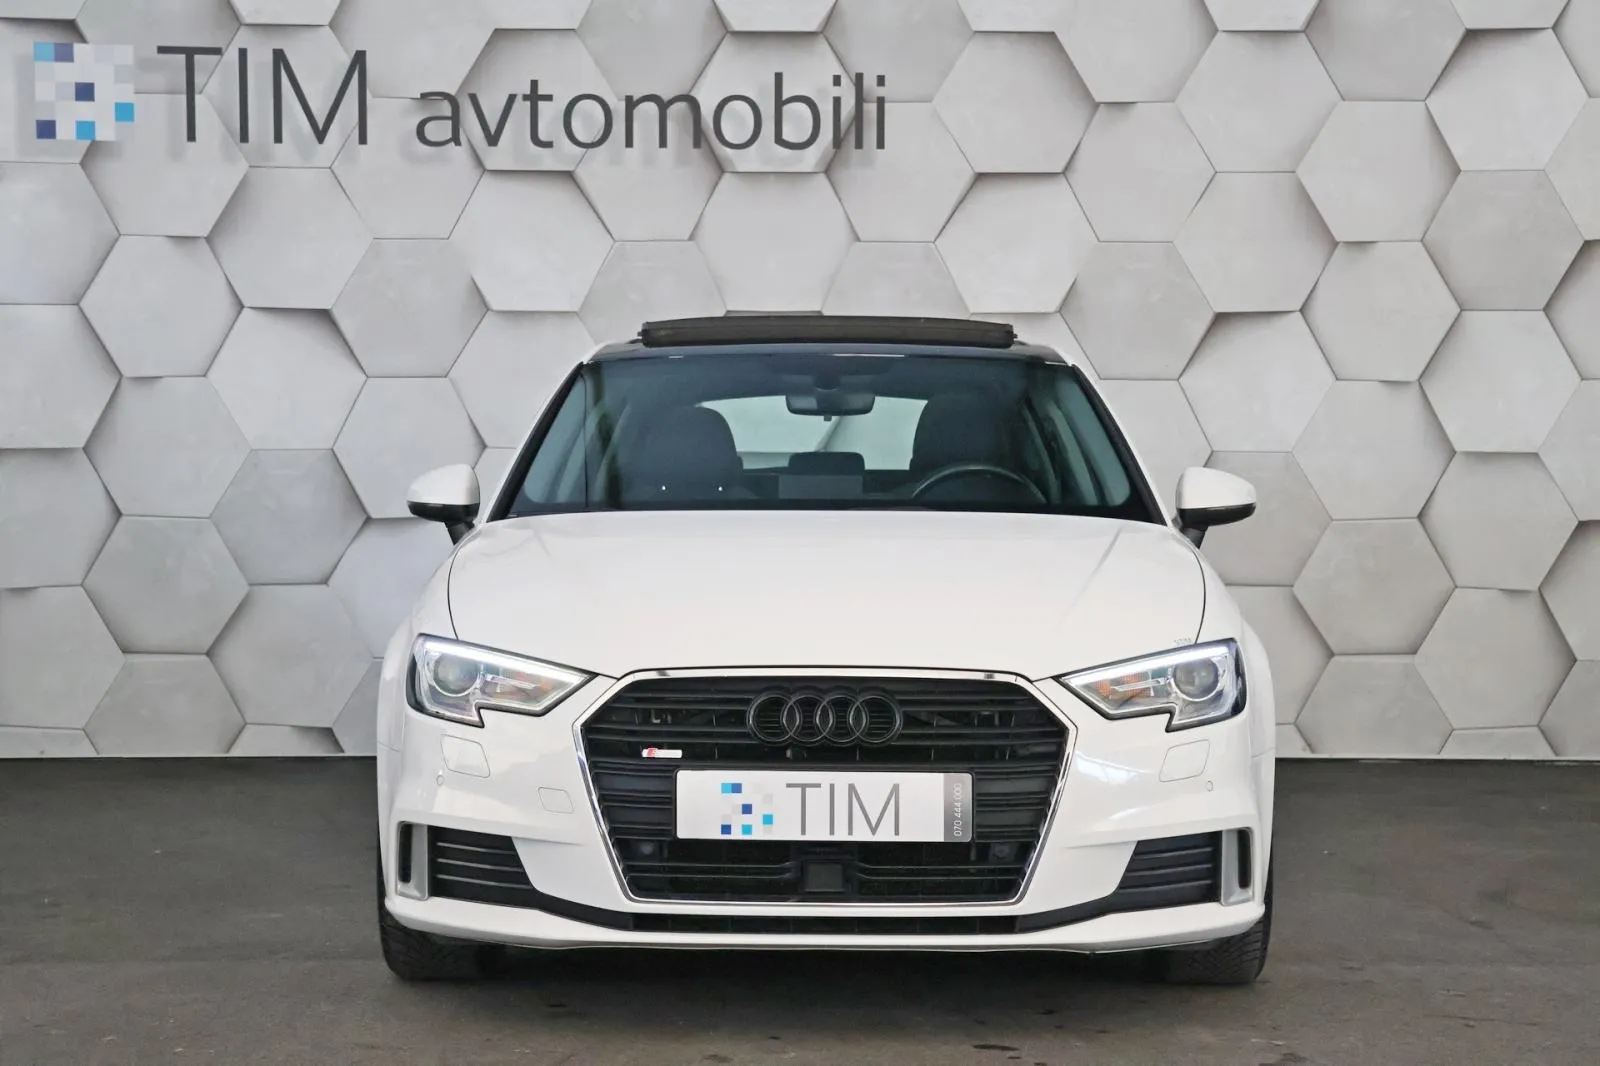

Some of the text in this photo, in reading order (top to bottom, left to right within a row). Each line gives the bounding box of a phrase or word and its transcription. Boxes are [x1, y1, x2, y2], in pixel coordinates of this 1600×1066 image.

[157, 46, 887, 151] TIM avtomobili
[786, 783, 900, 836] TIM
[953, 783, 962, 837] 070 444 000
